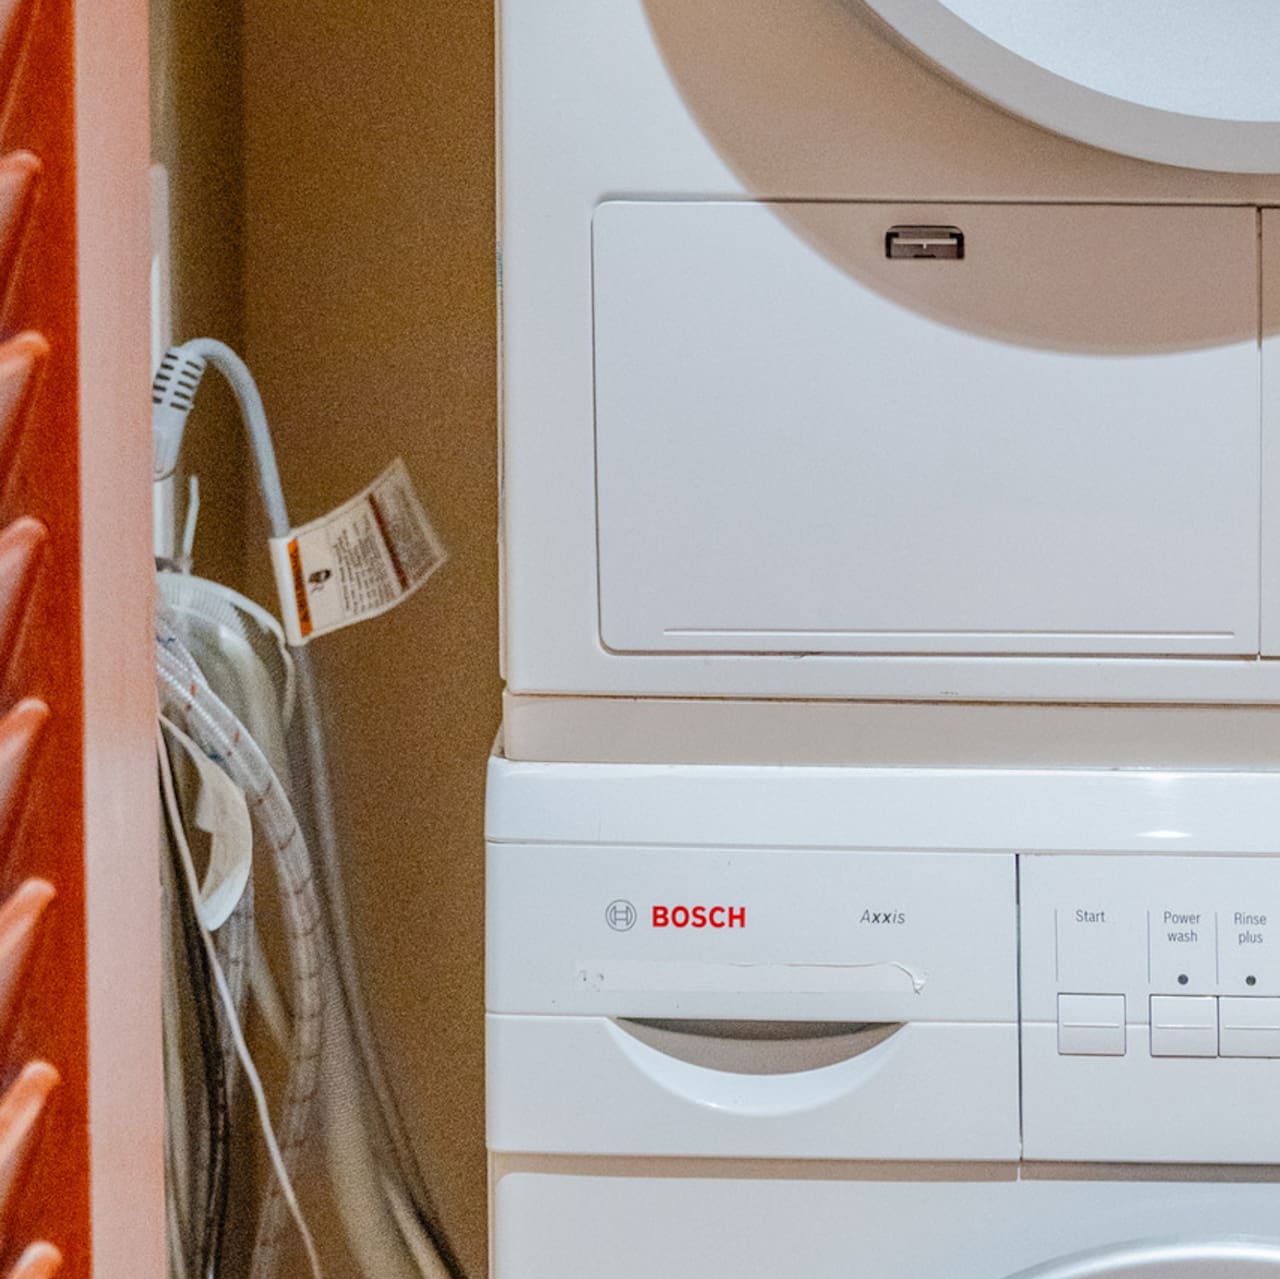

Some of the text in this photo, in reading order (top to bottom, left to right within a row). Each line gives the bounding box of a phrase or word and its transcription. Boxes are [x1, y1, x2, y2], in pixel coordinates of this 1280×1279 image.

[652, 906, 746, 928] BOSCH
[860, 909, 906, 925] Axxis
[1076, 909, 1105, 923] Start
[1163, 911, 1200, 925] Power
[1234, 912, 1267, 925] Rinse
[1167, 929, 1198, 943] wash
[1238, 931, 1263, 945] plus
